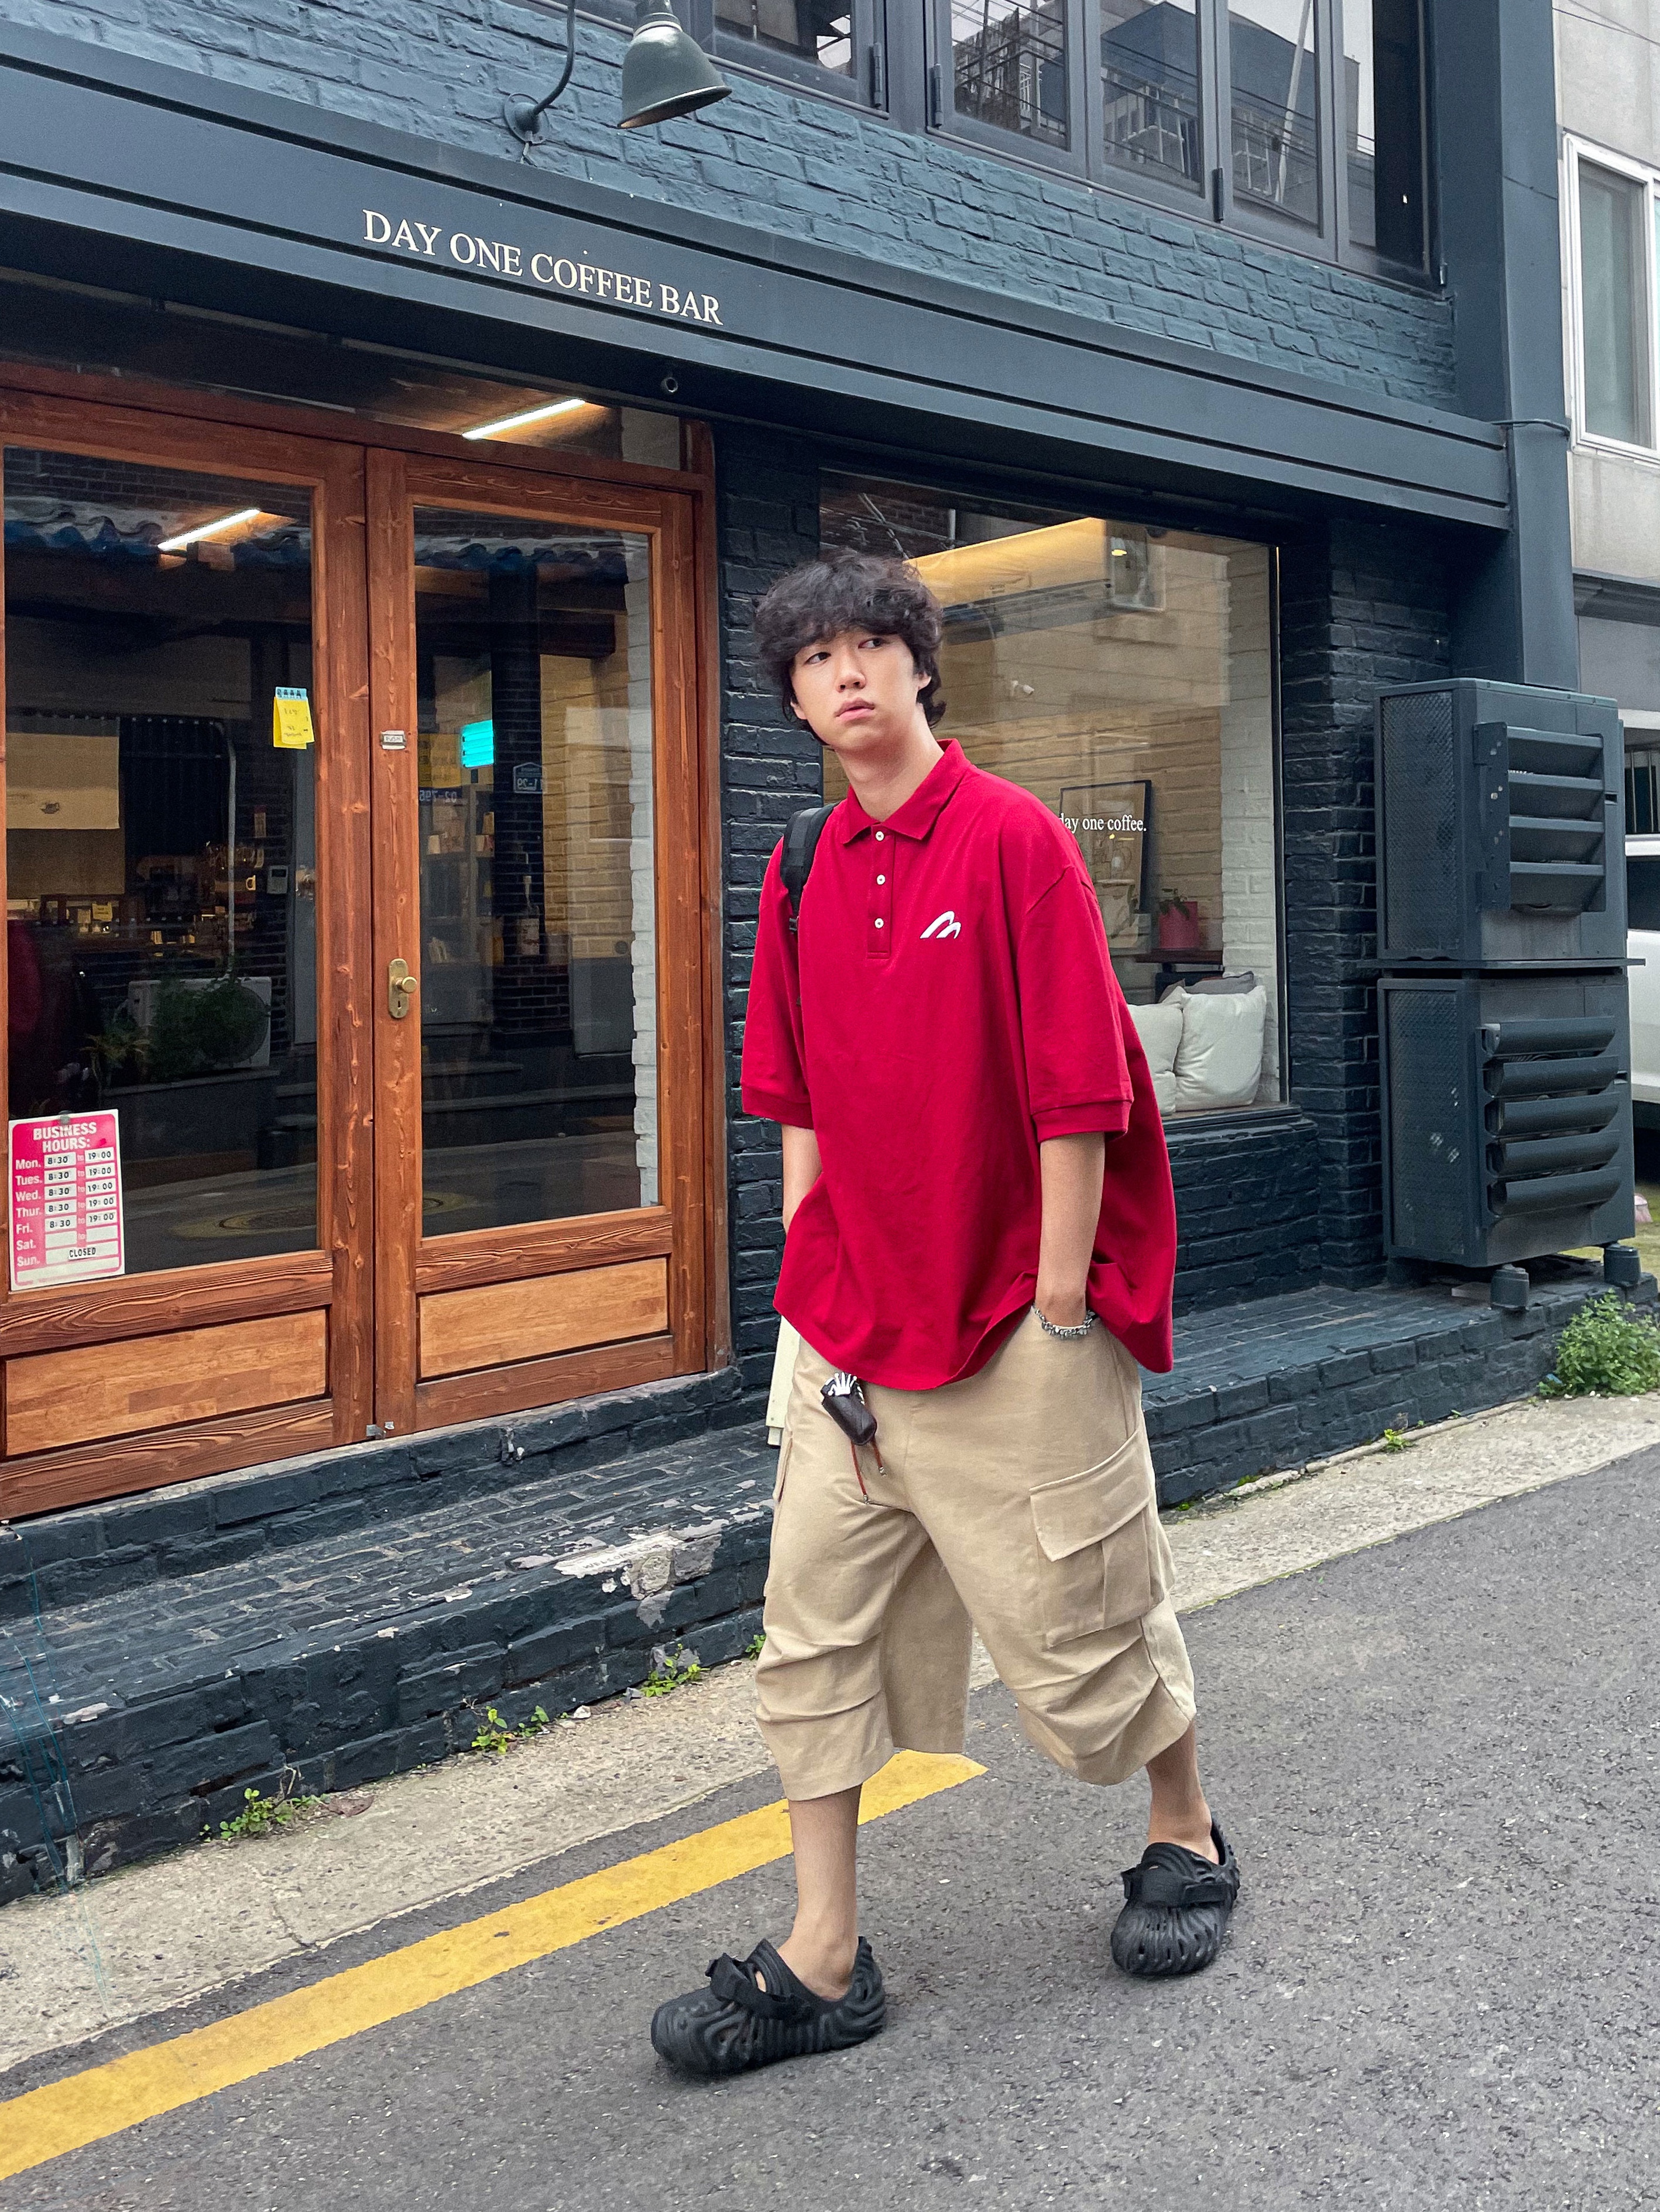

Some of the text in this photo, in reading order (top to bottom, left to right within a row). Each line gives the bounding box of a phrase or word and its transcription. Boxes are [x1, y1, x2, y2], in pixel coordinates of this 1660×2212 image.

[362, 209, 723, 325] DAY ONE COFFEE BAR
[1082, 818, 1105, 831] one
[1107, 814, 1147, 832] coffee.
[33, 1122, 97, 1141] BUSINESS
[43, 1137, 90, 1153] HOURS:
[15, 1159, 42, 1170] Mon.
[15, 1175, 43, 1186] Tues.
[15, 1190, 42, 1202] Wed.
[15, 1207, 43, 1218] Thur.
[16, 1222, 33, 1235] Fri.
[16, 1239, 36, 1251] Sat.
[16, 1247, 96, 1267] Sun. CLOSED
